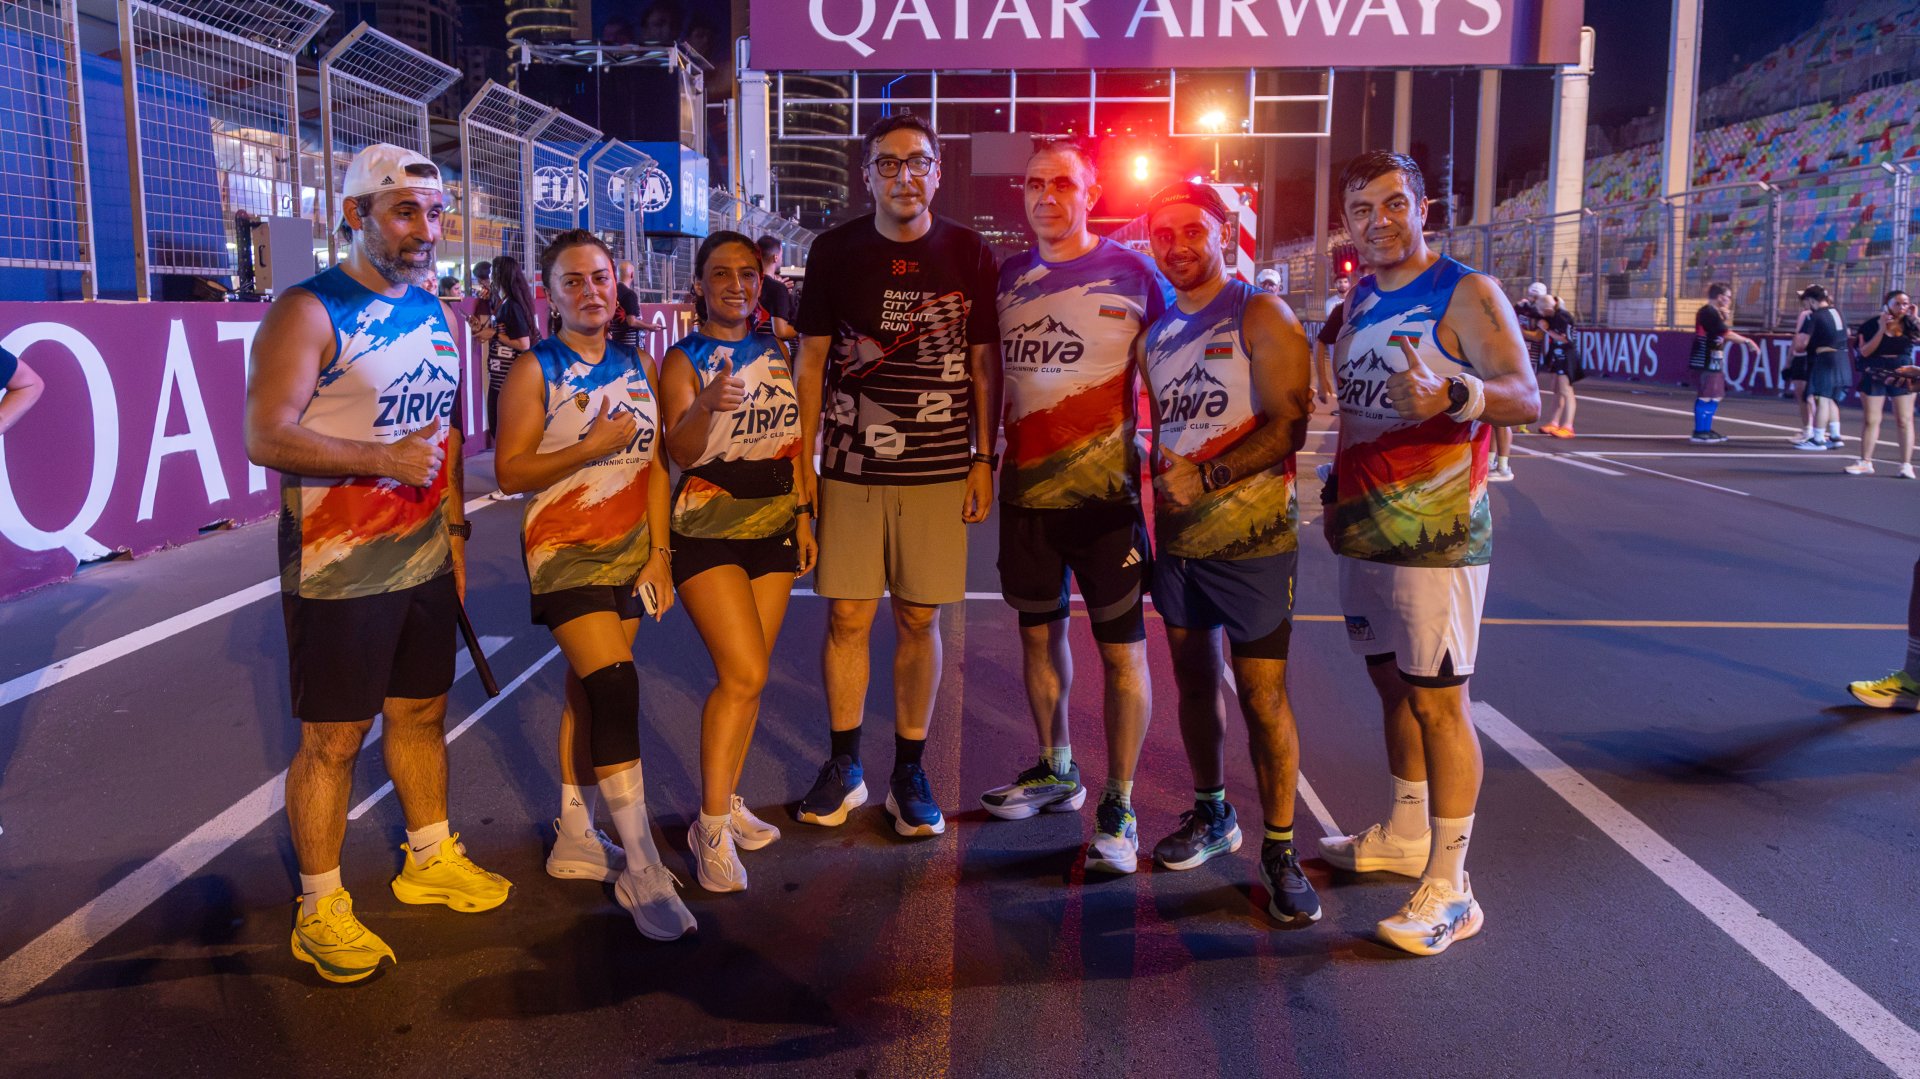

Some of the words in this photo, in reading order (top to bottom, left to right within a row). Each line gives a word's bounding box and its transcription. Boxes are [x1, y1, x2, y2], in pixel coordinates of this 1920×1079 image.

[808, 0, 1100, 57] QATAR
[1124, 0, 1502, 38] AIRWAYS
[883, 289, 920, 300] BAKU
[882, 300, 913, 311] CITY
[881, 310, 933, 322] CIRCUIT
[880, 321, 910, 332] RUN
[916, 392, 953, 423] 2
[1189, 422, 1210, 430] CLUB
